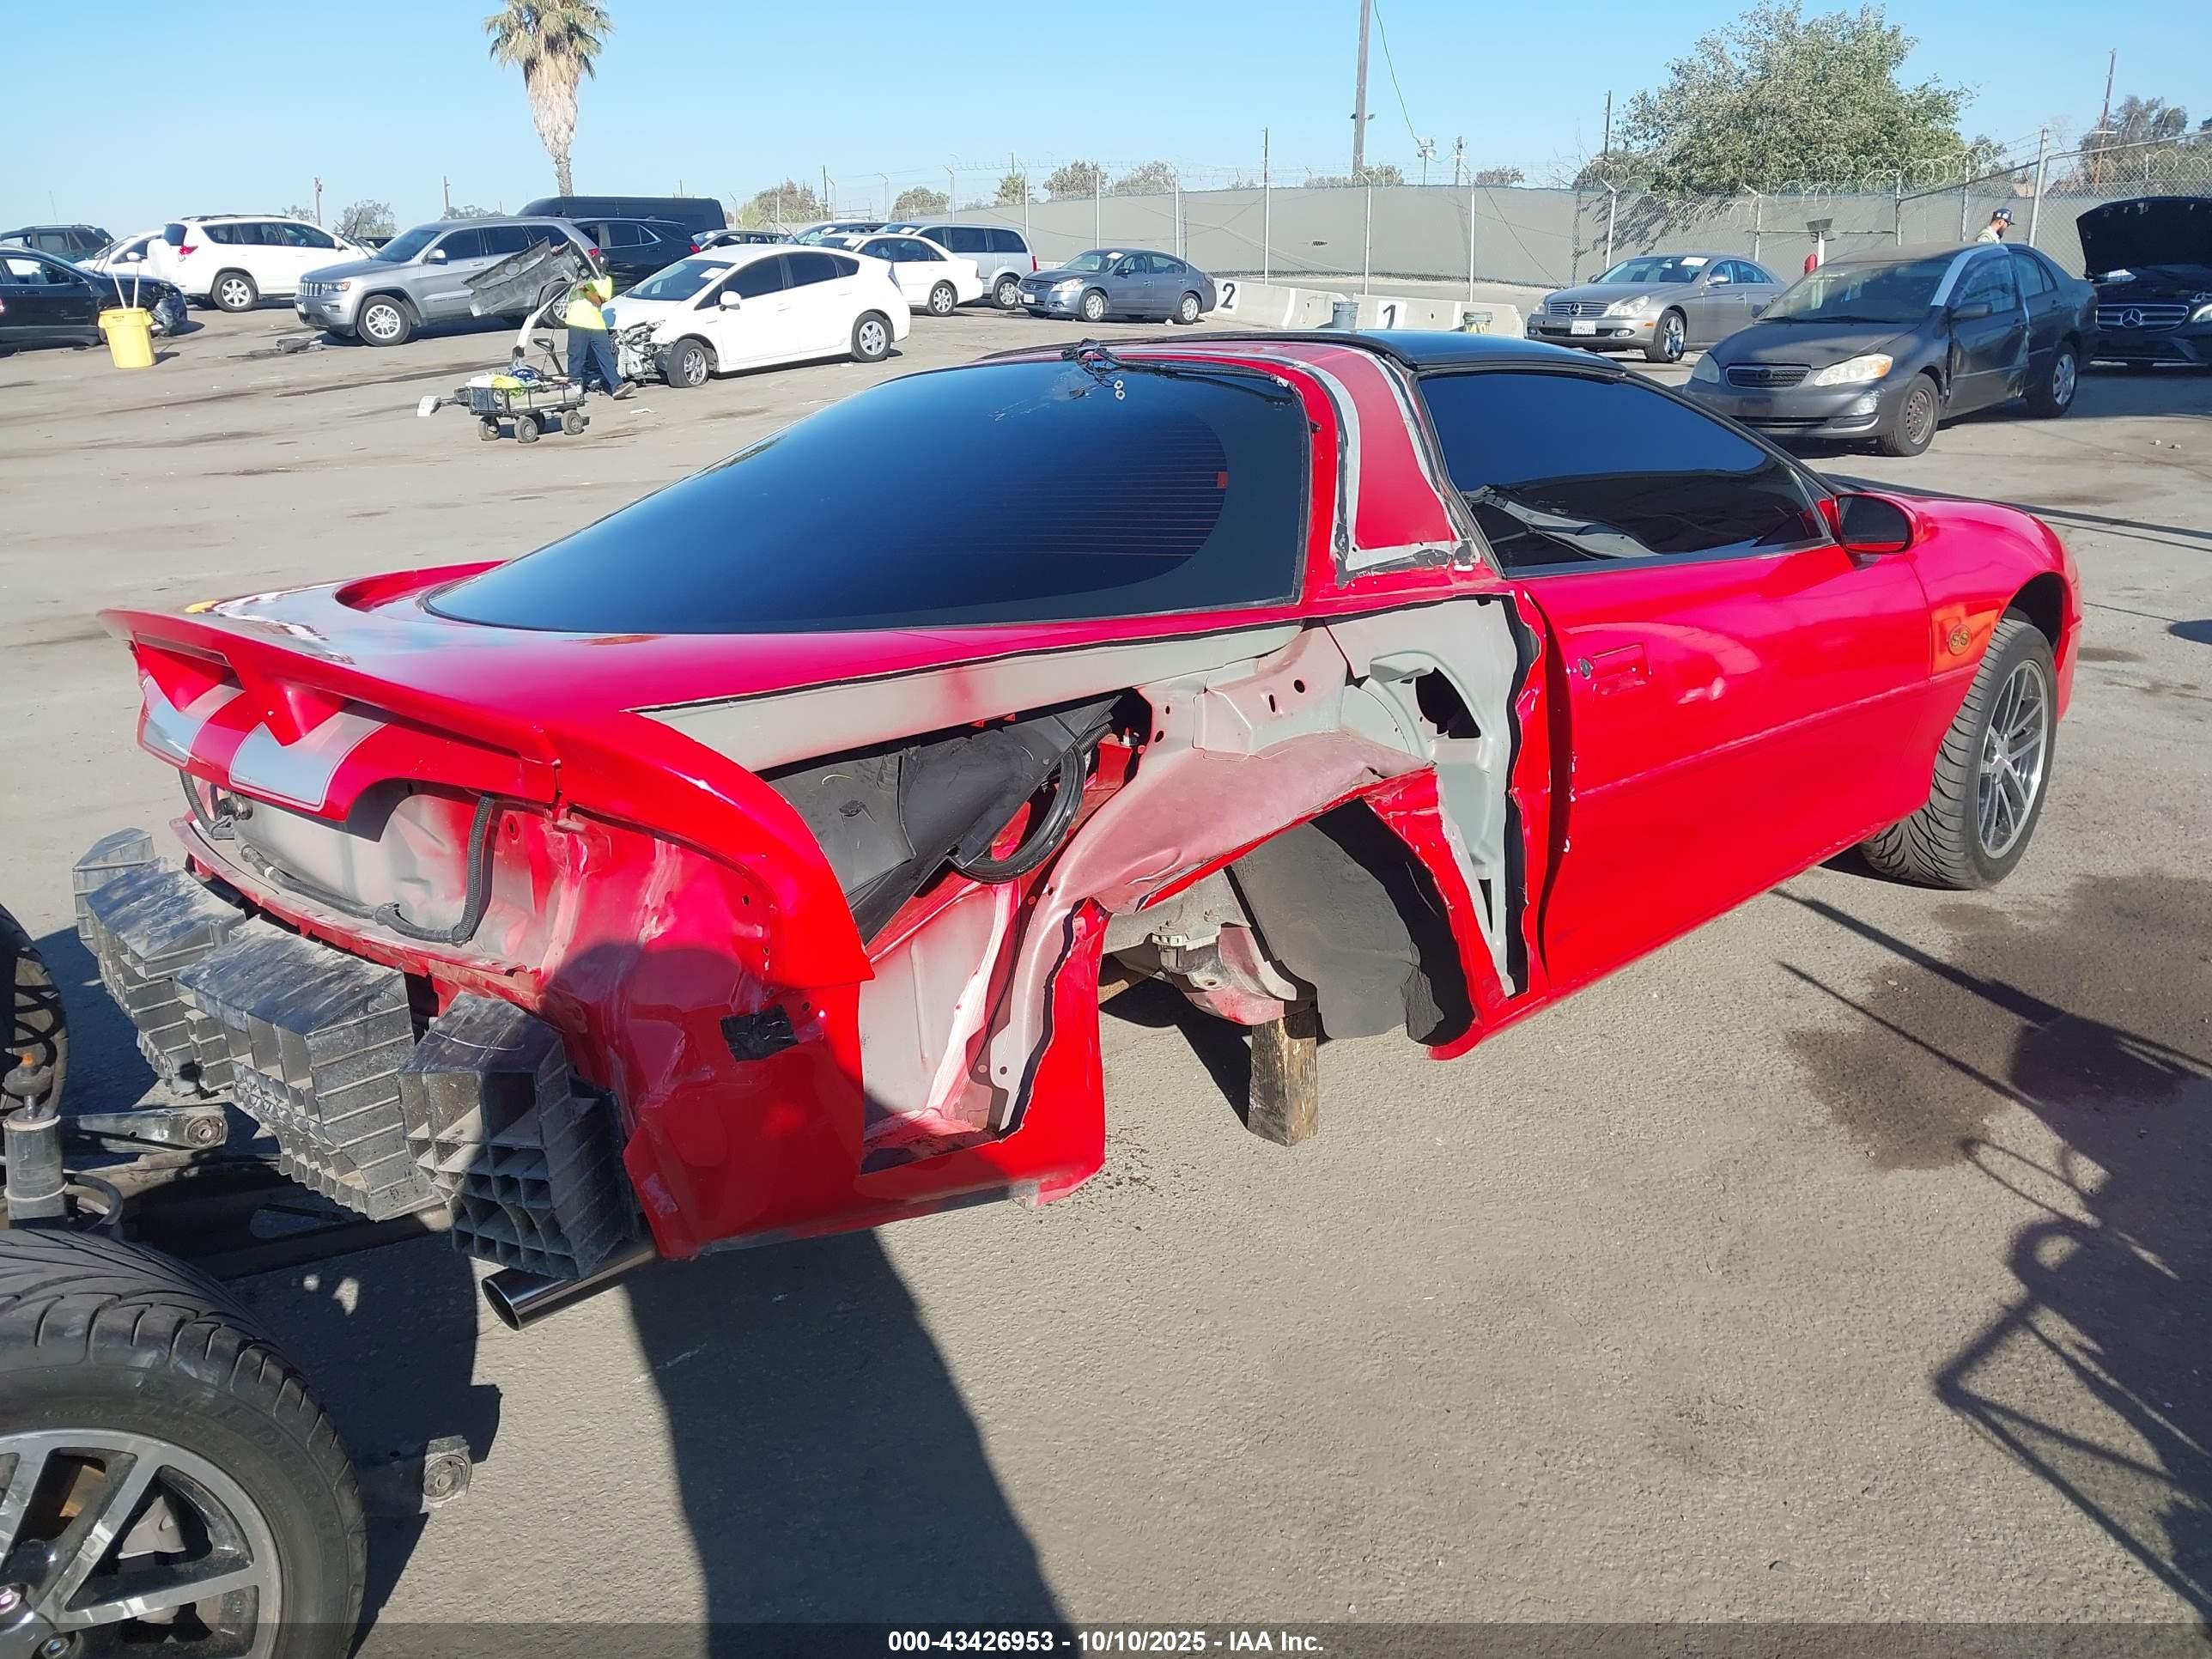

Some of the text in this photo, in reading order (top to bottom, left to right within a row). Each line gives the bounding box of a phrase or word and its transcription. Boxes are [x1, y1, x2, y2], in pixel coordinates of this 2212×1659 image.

[1220, 282, 1236, 309] 2
[1382, 303, 1396, 329] 1
[1951, 631, 1969, 647] SS
